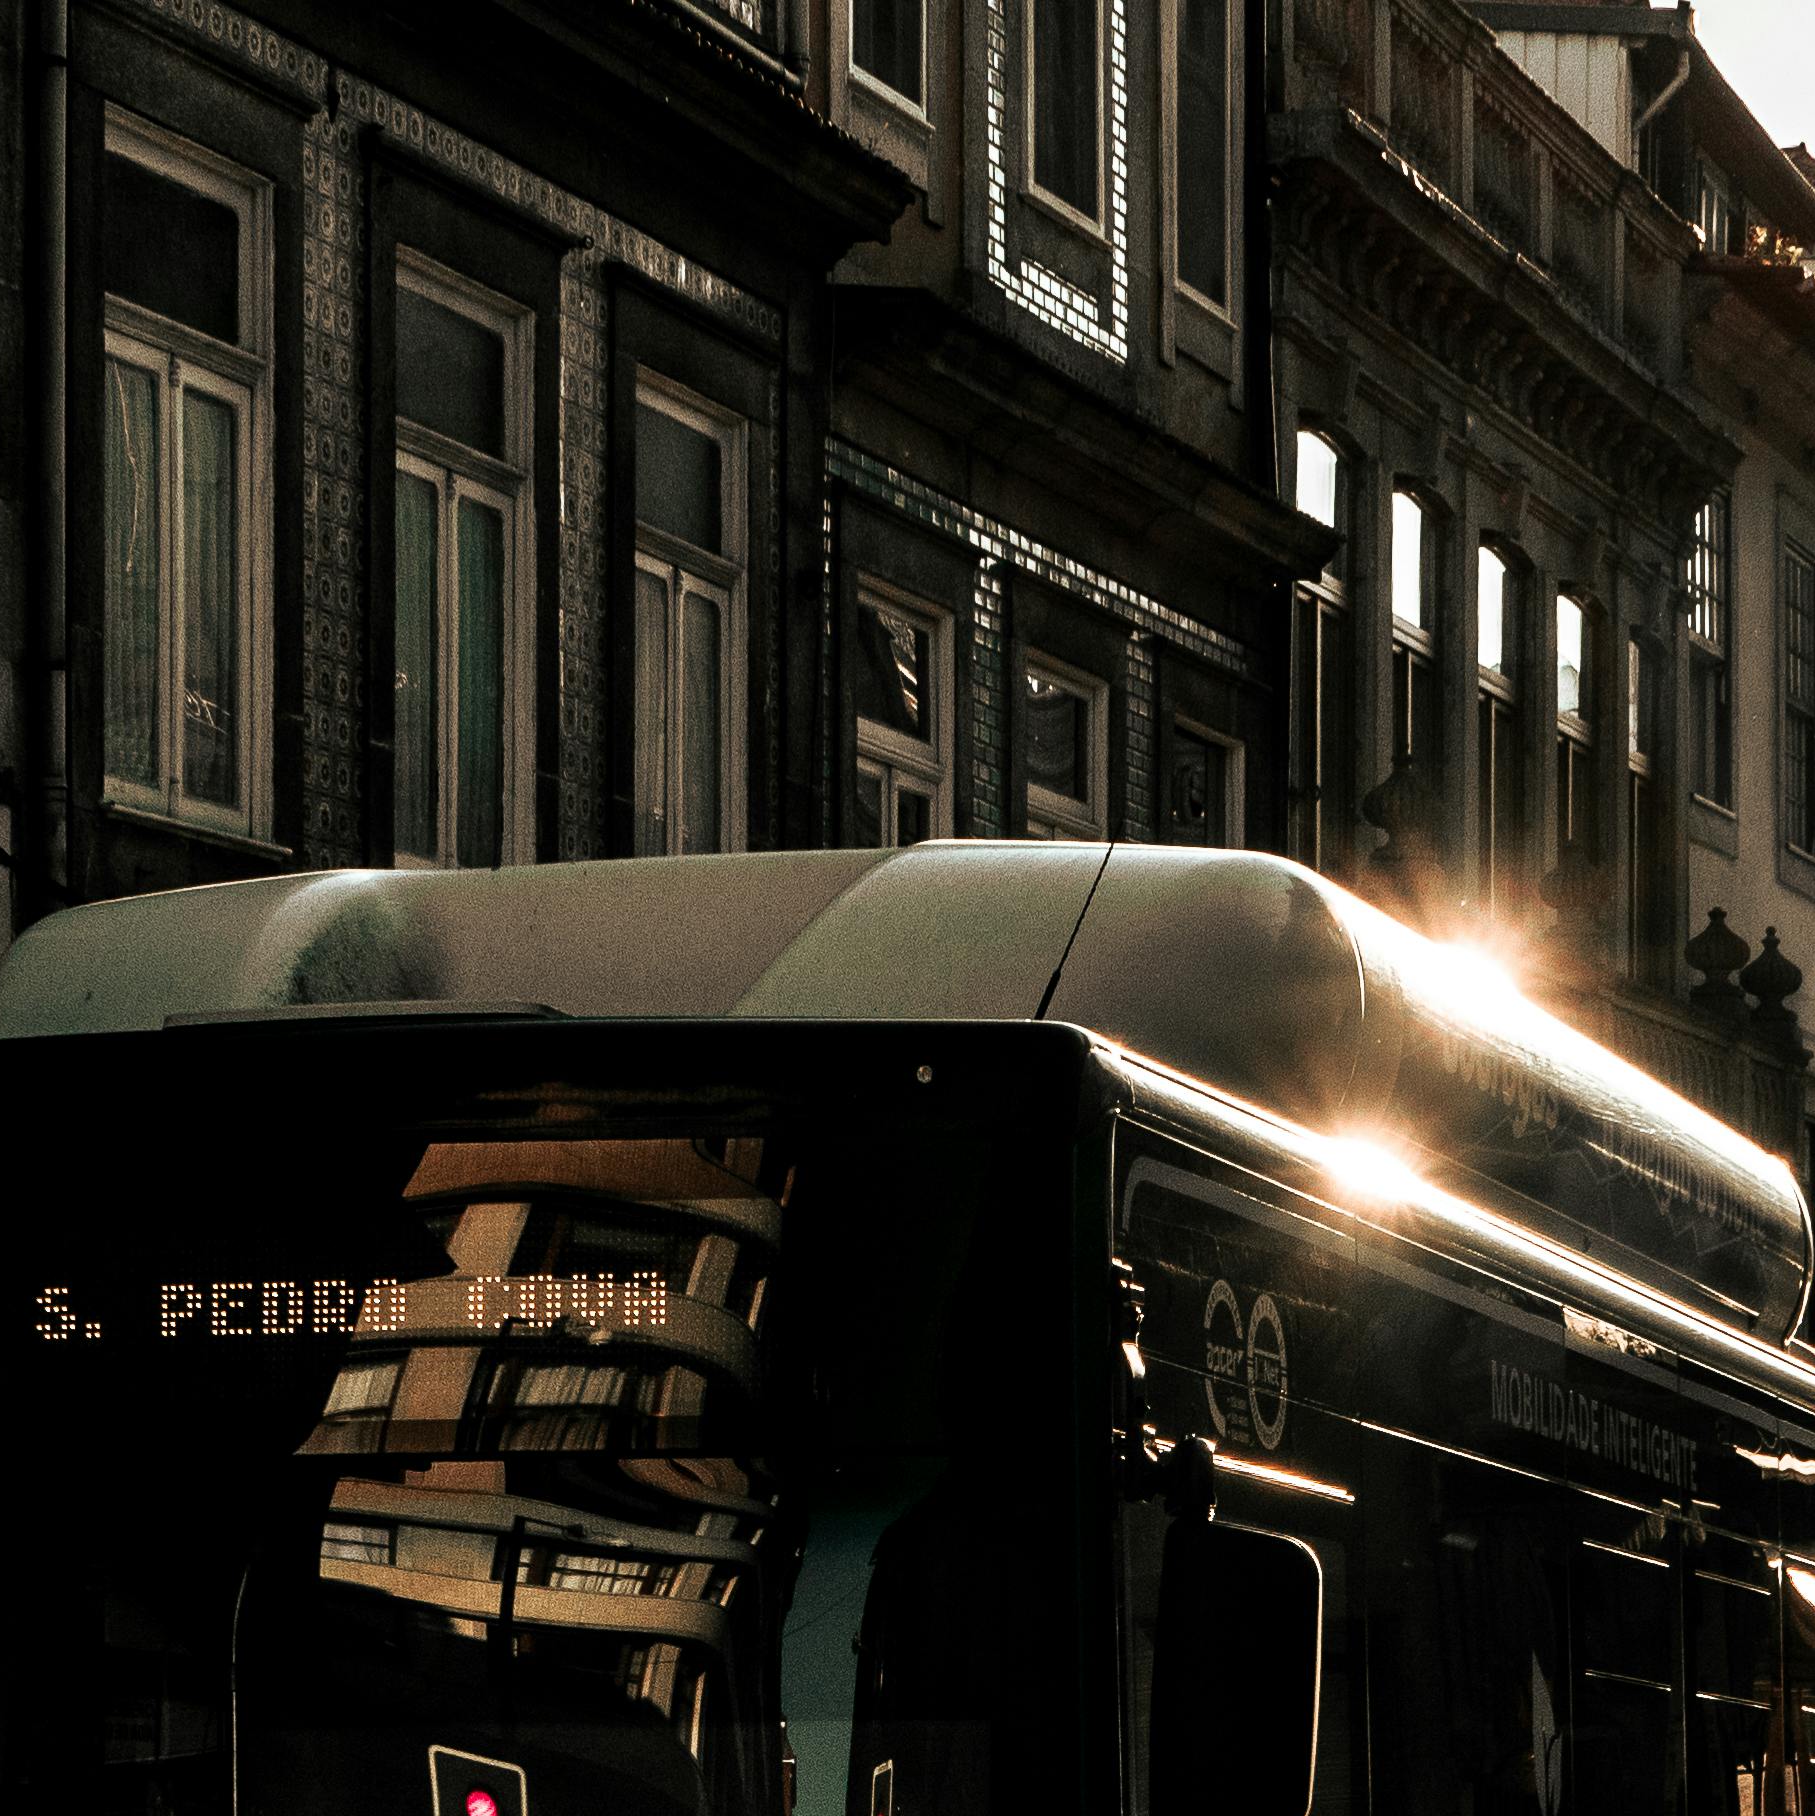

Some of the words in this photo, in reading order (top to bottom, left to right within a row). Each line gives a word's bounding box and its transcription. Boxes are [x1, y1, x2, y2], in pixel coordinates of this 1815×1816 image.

[34, 1285, 102, 1341] S.
[161, 1279, 407, 1337] PEDRO
[467, 1272, 667, 1329] COVA
[1490, 1360, 1600, 1456] MOBILIDADE
[1604, 1403, 1698, 1493] INTELIGENTE
